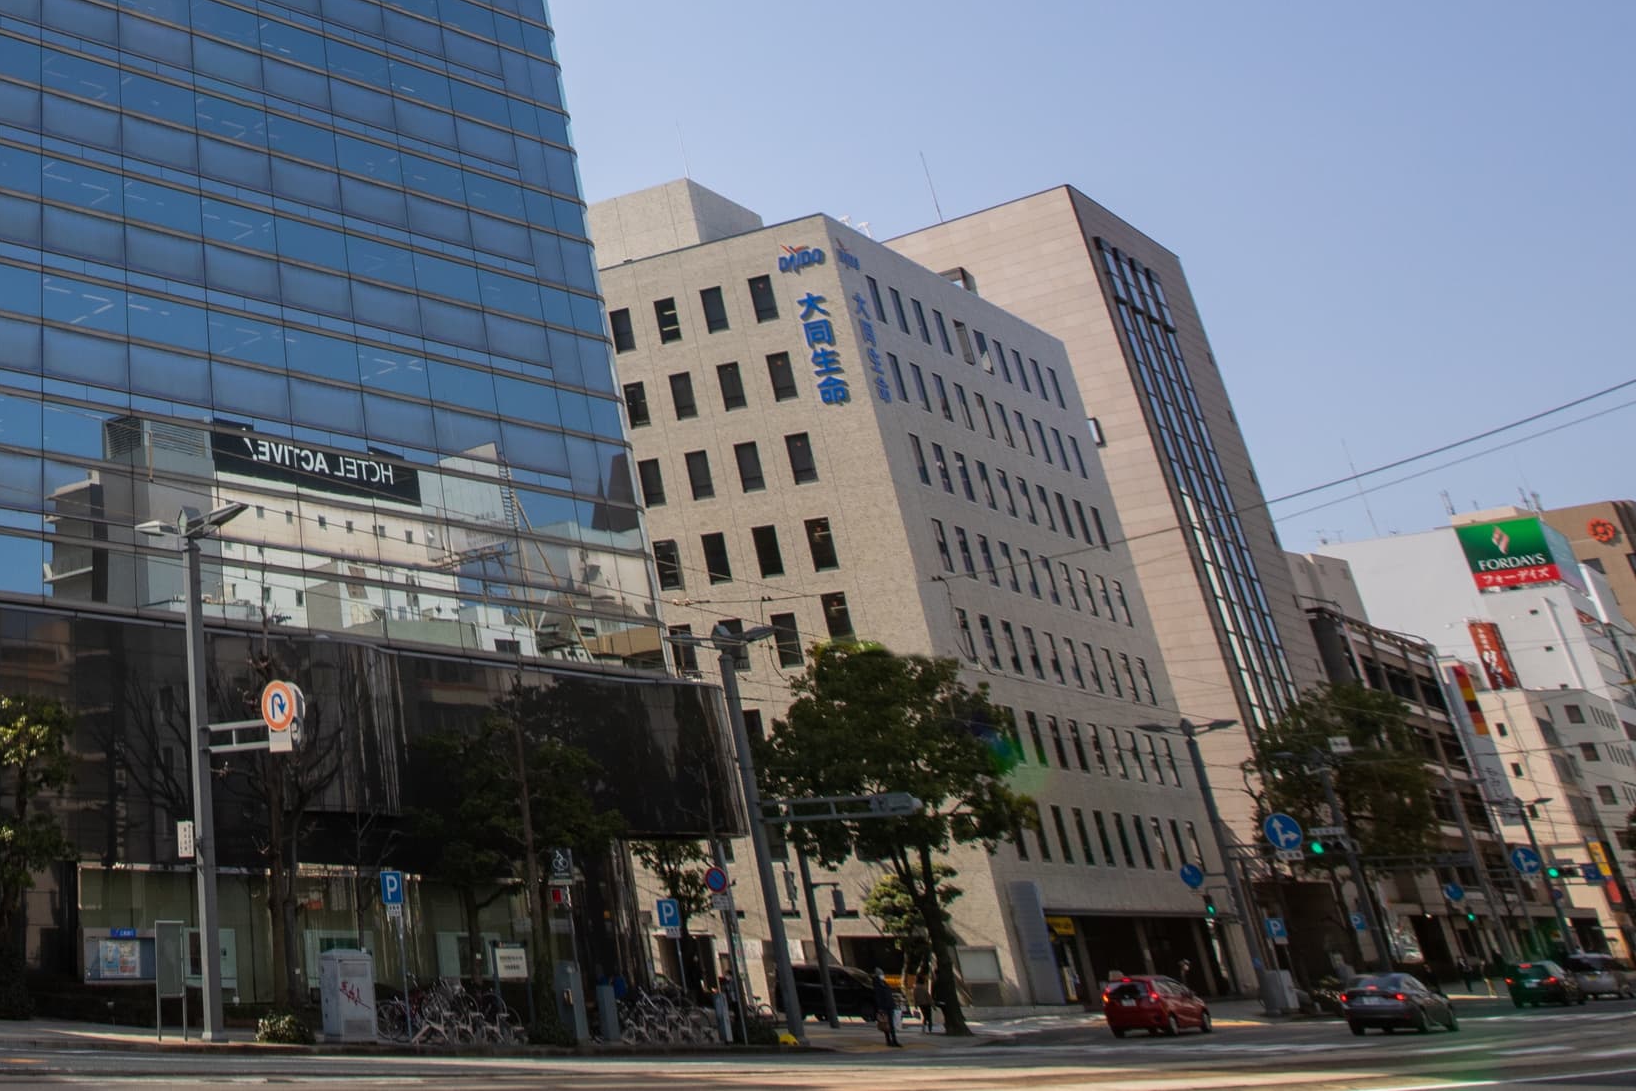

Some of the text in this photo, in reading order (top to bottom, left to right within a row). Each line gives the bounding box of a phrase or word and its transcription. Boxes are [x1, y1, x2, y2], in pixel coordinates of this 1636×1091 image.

[778, 246, 826, 274] DAIDO
[797, 292, 851, 406] 大同生命
[1478, 553, 1547, 571] FORDAYS
[385, 875, 398, 900] P
[661, 902, 674, 924] P
